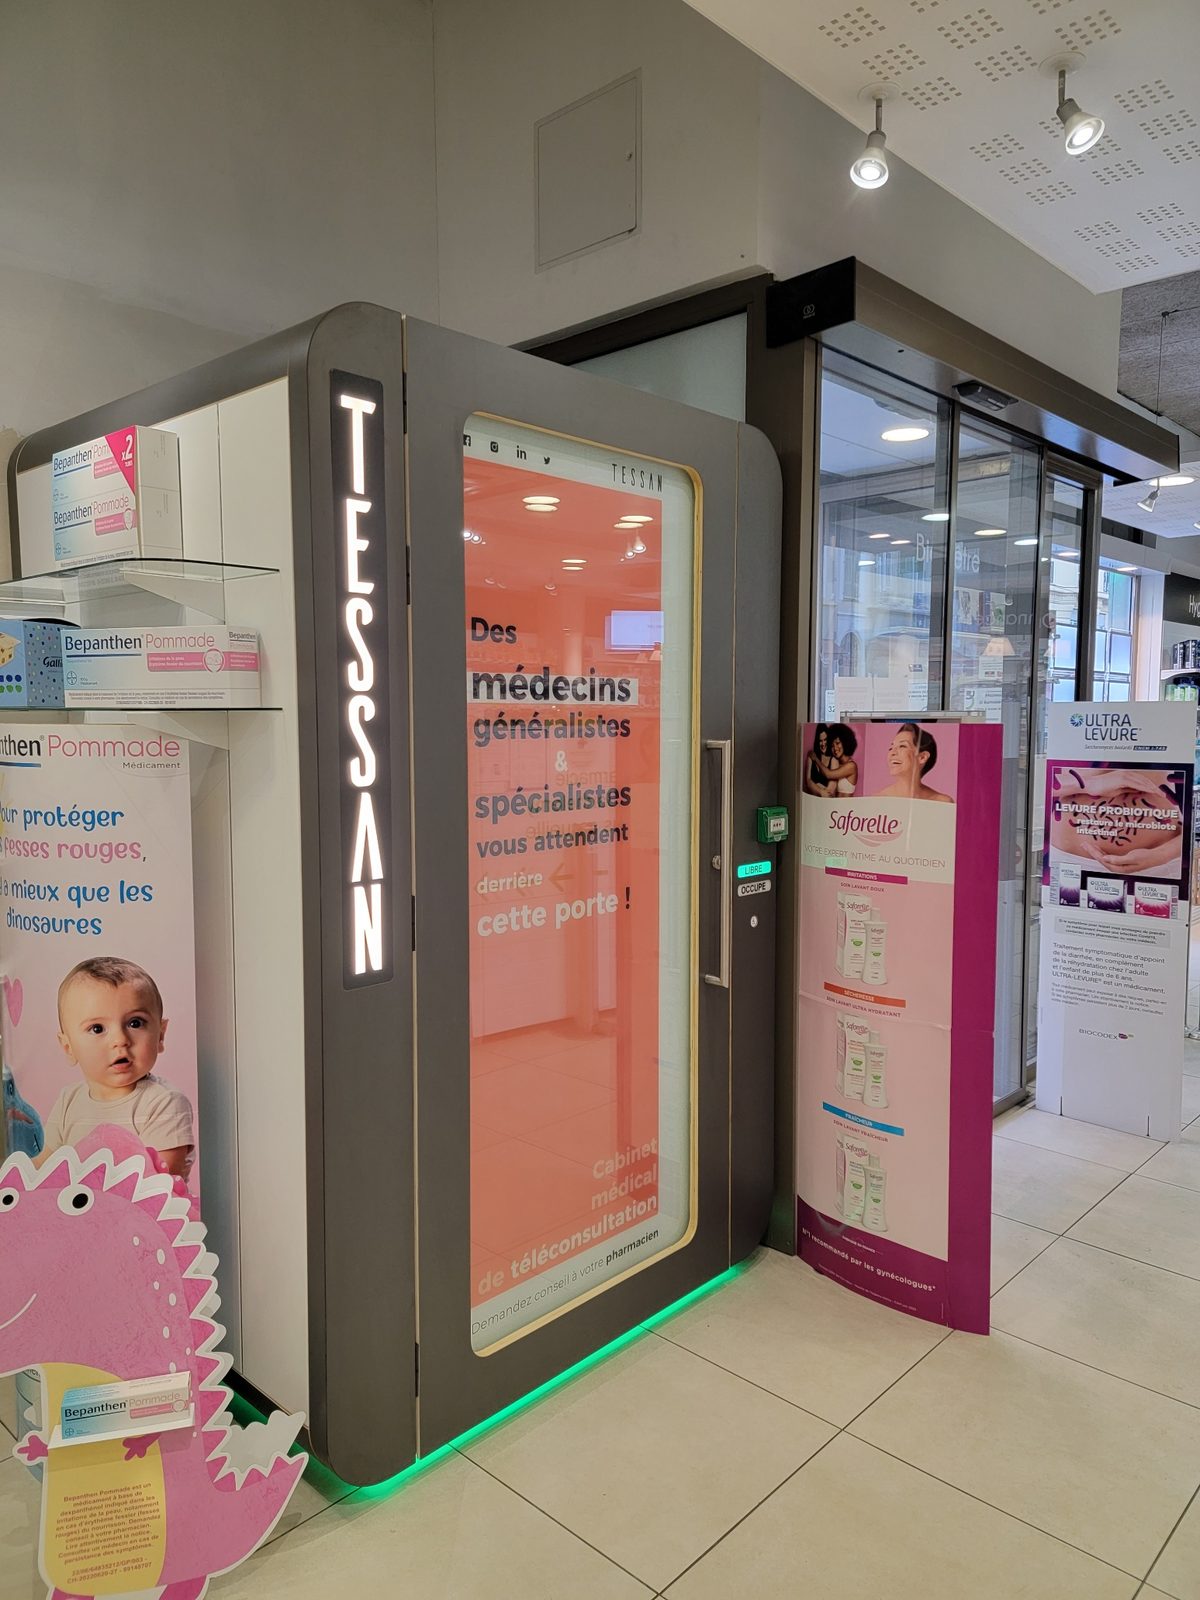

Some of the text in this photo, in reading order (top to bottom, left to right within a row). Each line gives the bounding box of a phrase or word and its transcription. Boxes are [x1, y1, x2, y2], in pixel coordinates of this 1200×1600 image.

[53, 449, 92, 471] Bepanthen
[611, 463, 664, 493] TESSAN
[53, 505, 92, 525] Bepanthen
[93, 494, 129, 514] Pommade
[65, 632, 215, 654] Bepanthen Pommade
[470, 616, 518, 644] Des
[340, 393, 384, 976] TESSAN
[472, 664, 632, 702] médecins
[473, 711, 631, 748] généralistes
[1084, 727, 1139, 741] LEVURE
[1085, 713, 1132, 727] ULTRA
[47, 734, 181, 758] Pommade
[122, 761, 181, 769] Médicament
[555, 750, 568, 773] &
[475, 782, 632, 824] spécialistes
[1055, 802, 1179, 819] LEVURE PROBIOTIQUE
[0, 803, 125, 832] our protéger
[828, 809, 900, 836] Saforelle
[1076, 817, 1177, 832] restaure le microbiote
[477, 834, 528, 858] vous
[534, 823, 629, 852] attendent
[1076, 827, 1119, 837] intestinal
[4, 836, 147, 864] fesses rouges,
[804, 844, 823, 855] VOTRE
[824, 847, 849, 857] EXPERT
[878, 855, 892, 864] AU
[893, 856, 946, 868] QUOTIDIEN
[476, 868, 543, 896] derrière
[744, 864, 763, 875] LIBRE
[11, 879, 153, 909] mieux que les
[6, 906, 102, 935] dinosaures
[477, 886, 631, 937] cette porte !
[1053, 942, 1165, 964] Traitement symptomatique d'appoint
[1091, 970, 1105, 978] plus
[1078, 1028, 1118, 1040] BIOCODEX
[592, 1138, 658, 1180] Cabinet
[591, 1164, 657, 1210] médical
[478, 1195, 658, 1295] de téléconsultation
[811, 1234, 849, 1260] recommandé
[850, 1257, 863, 1268] par
[863, 1261, 875, 1272] les
[471, 1228, 660, 1335] Demandez conseil à votre pharmacien
[64, 1400, 127, 1420] Bepanthen
[128, 1391, 181, 1408] Pommade
[63, 1491, 98, 1503] Bepanthen
[99, 1485, 130, 1496] Pommade
[73, 1495, 112, 1507] médicament
